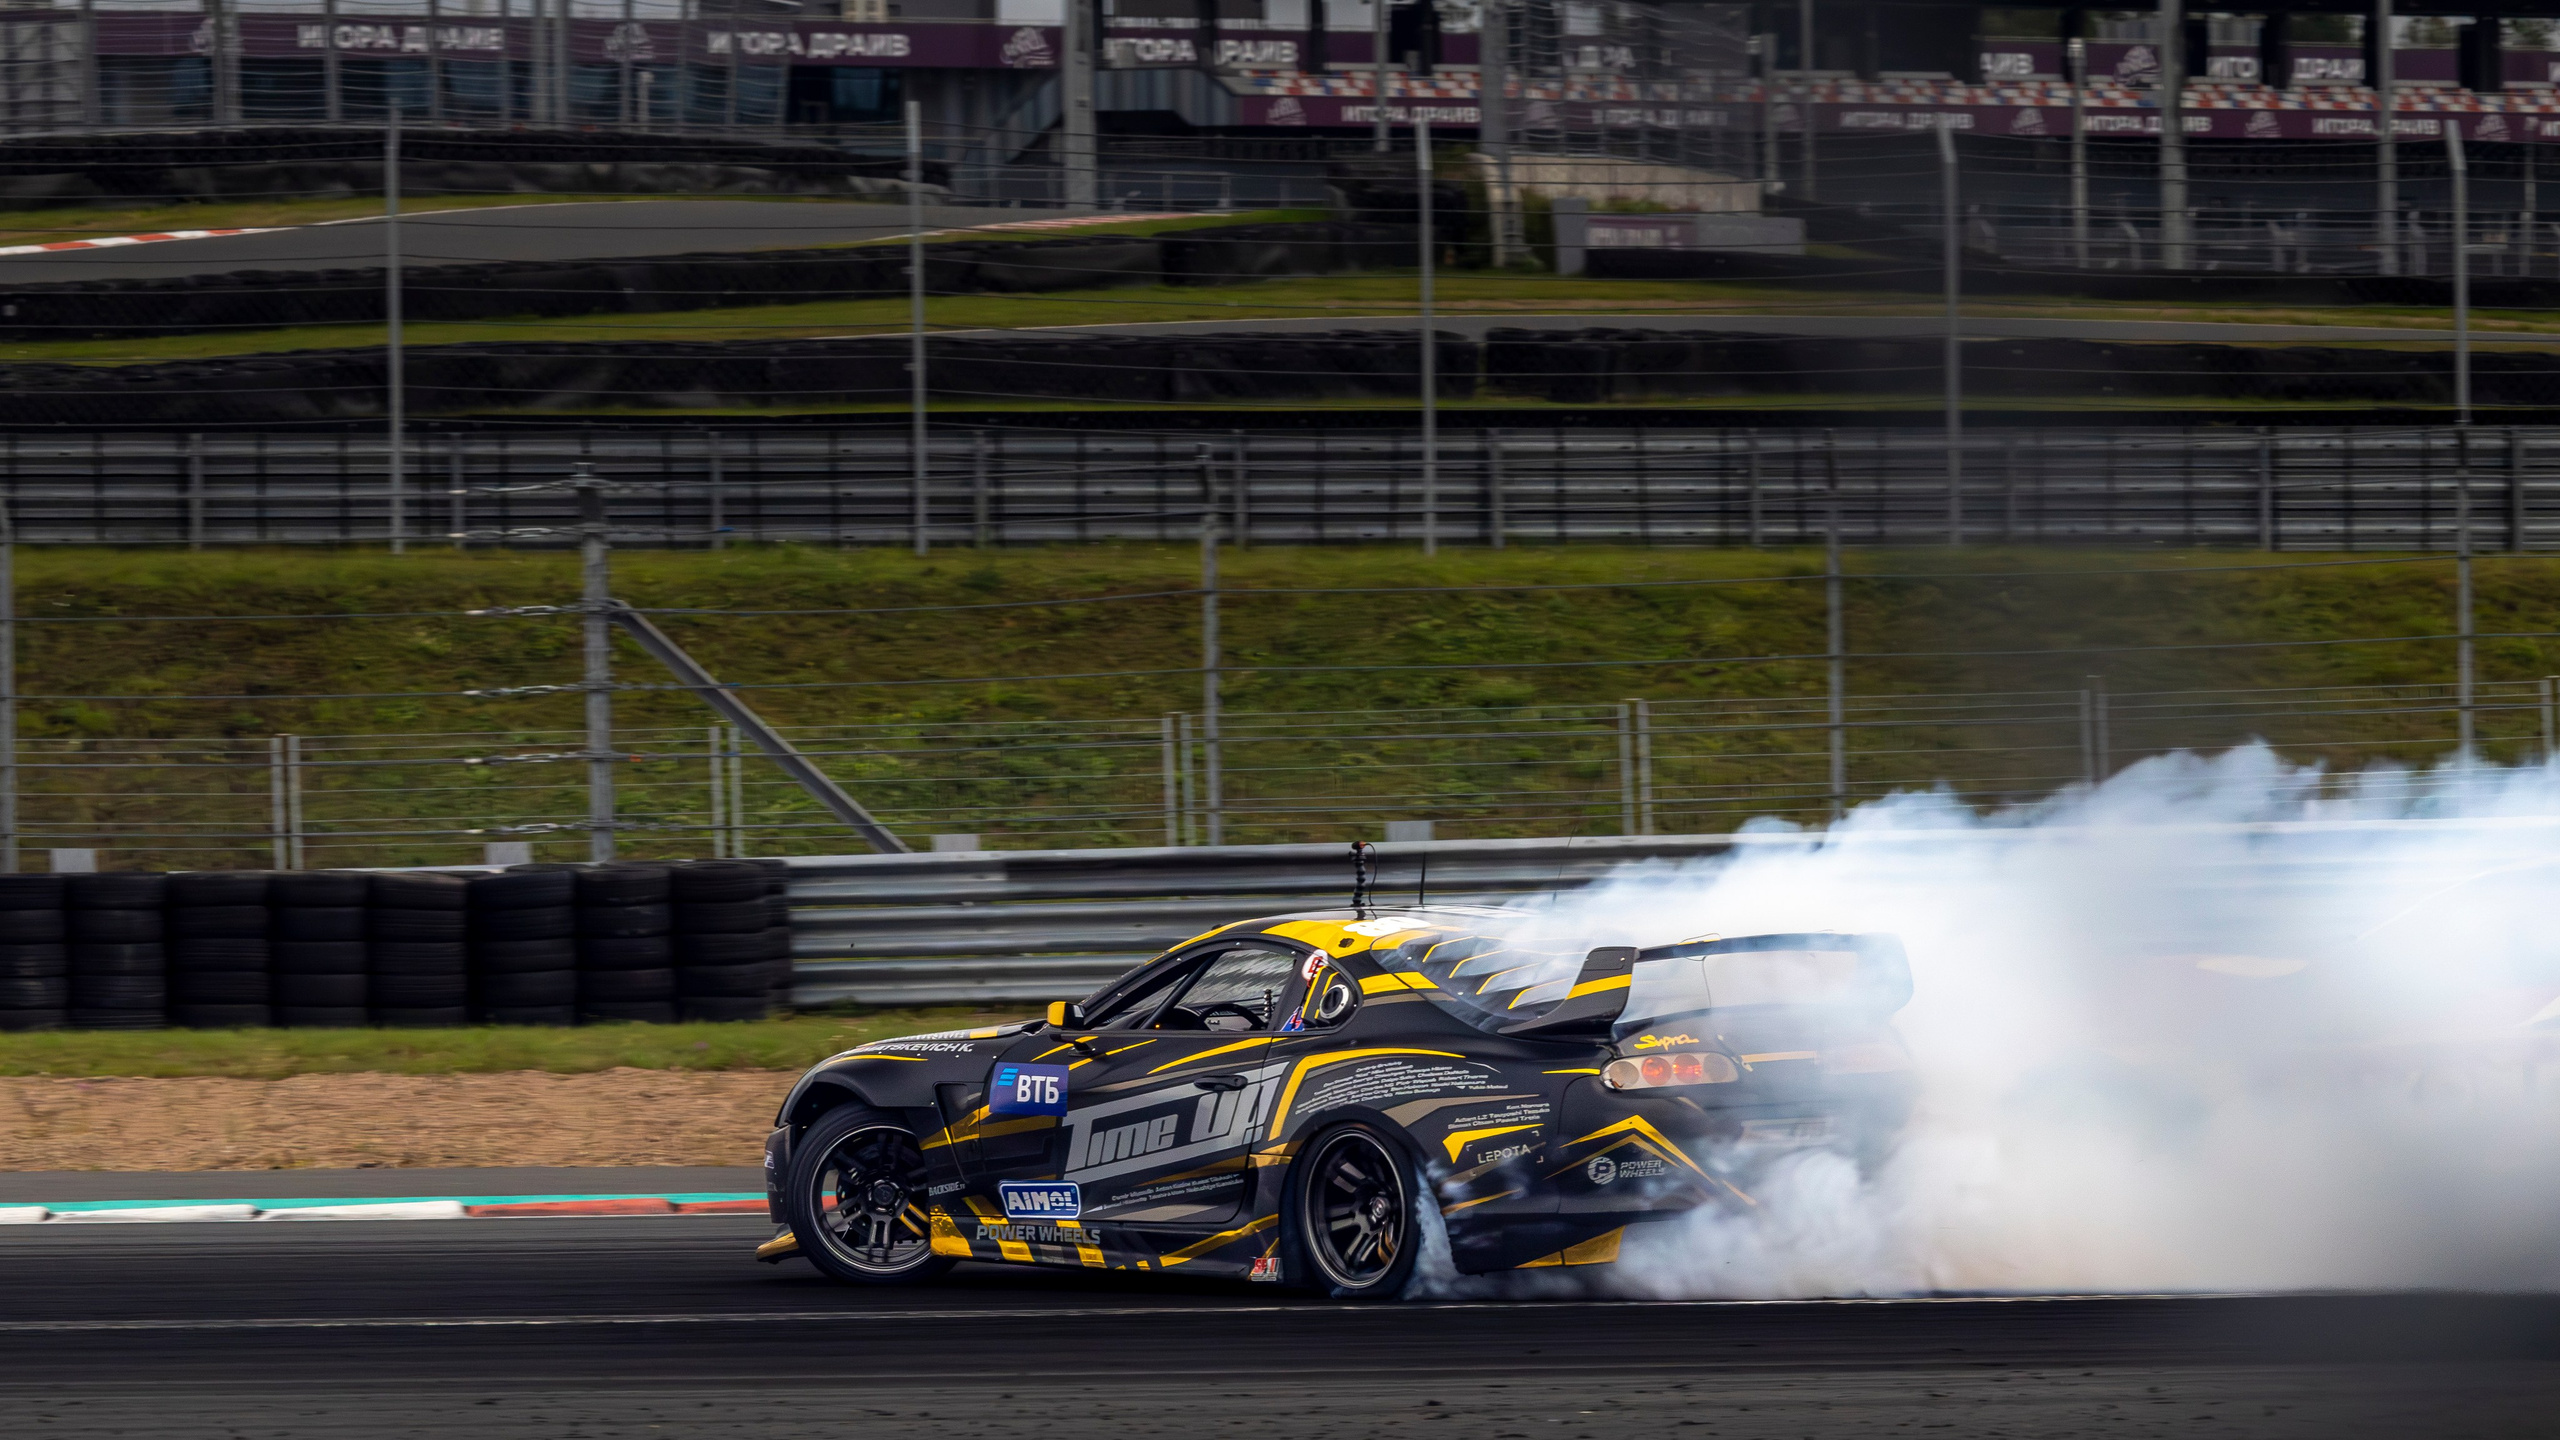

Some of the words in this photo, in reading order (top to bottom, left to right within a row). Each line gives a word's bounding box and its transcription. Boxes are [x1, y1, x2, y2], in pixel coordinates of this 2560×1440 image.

[1633, 1034, 1700, 1052] Supra
[1016, 1074, 1060, 1105] ВТБ
[1477, 1143, 1531, 1164] LEPOTA
[1619, 1167, 1666, 1179] WHEELS
[1620, 1159, 1663, 1170] POWER
[976, 1224, 1036, 1241] POWER
[1038, 1226, 1101, 1245] WHEELS
